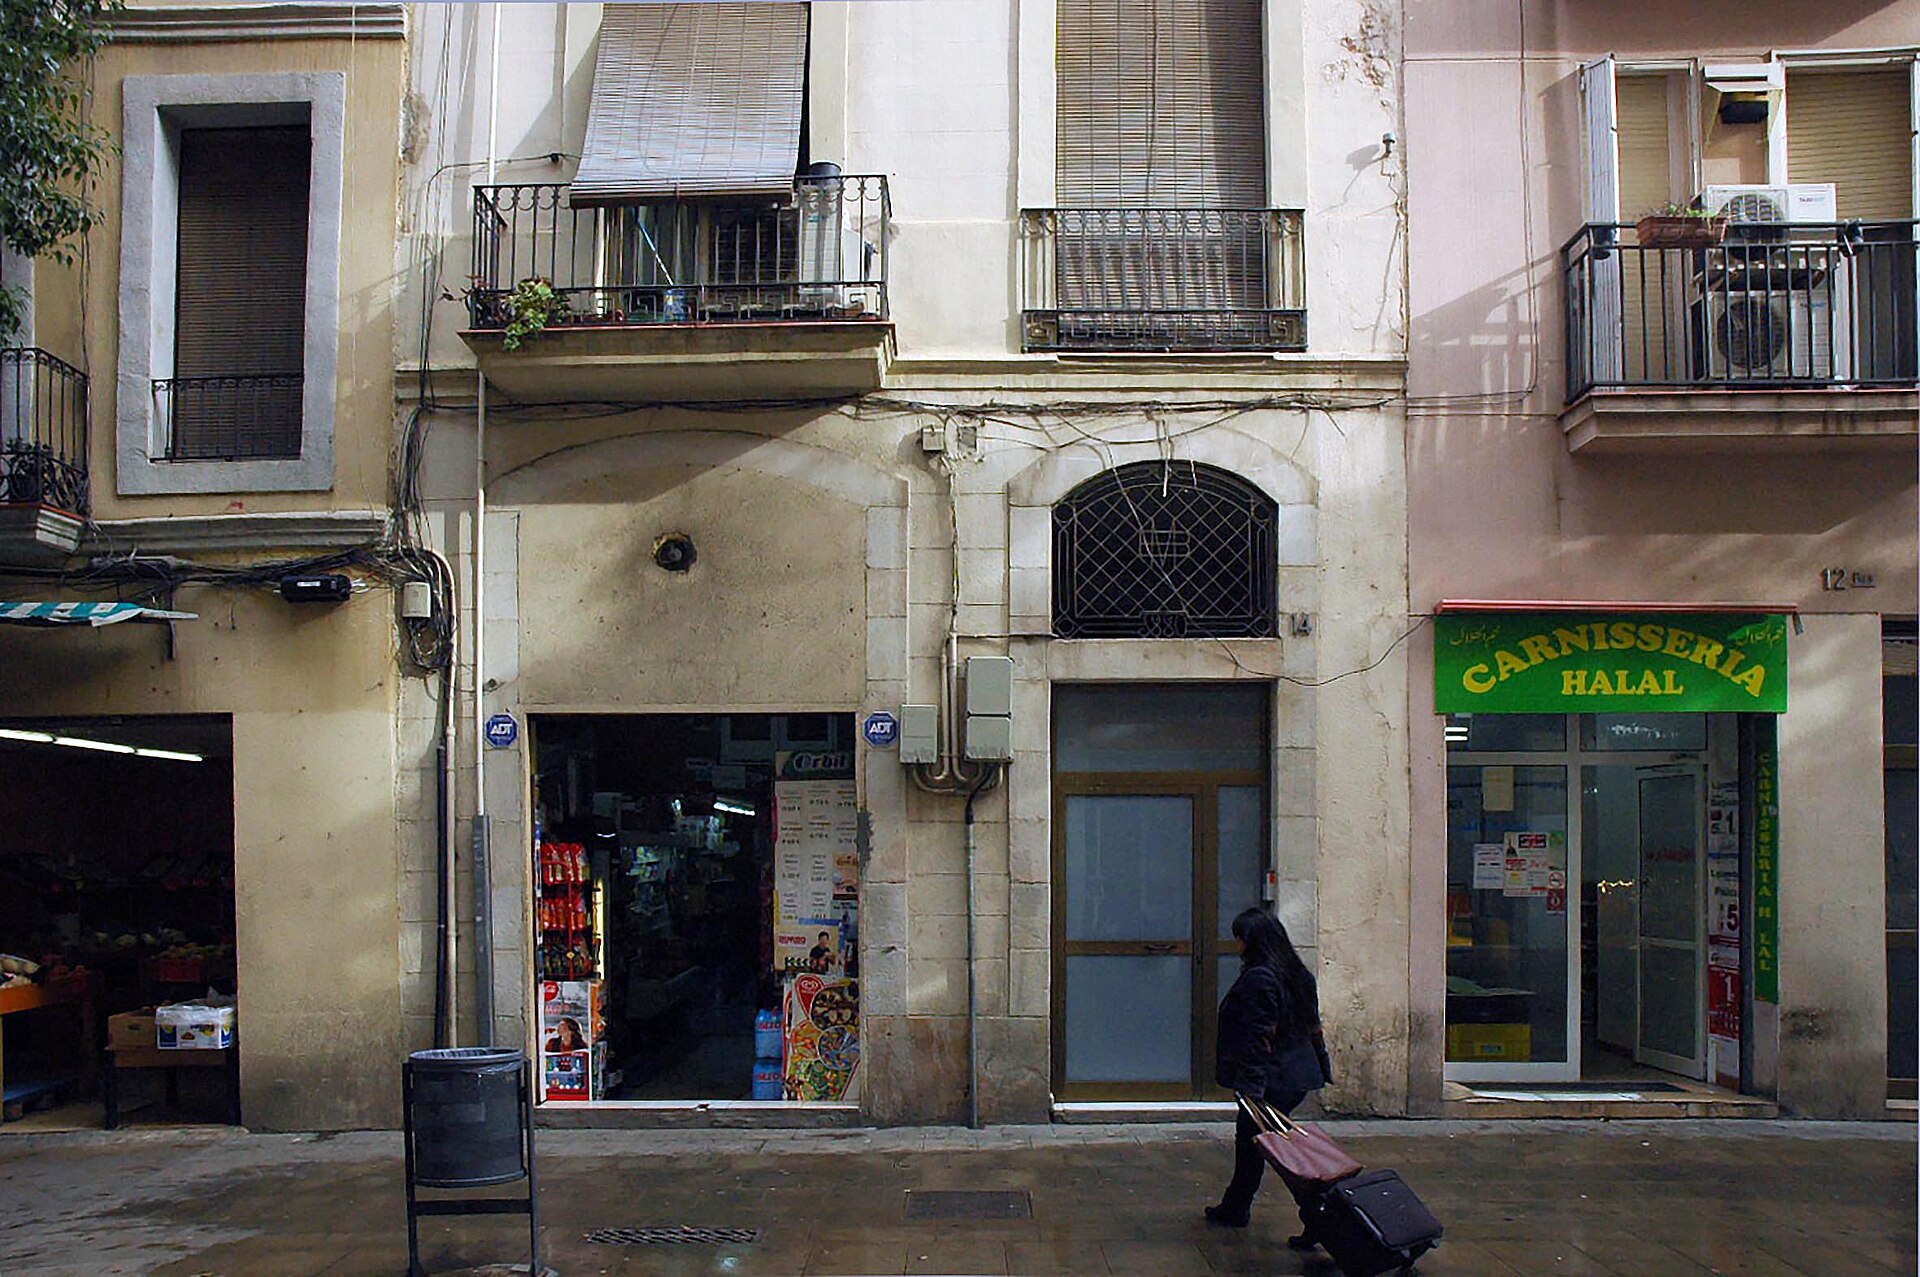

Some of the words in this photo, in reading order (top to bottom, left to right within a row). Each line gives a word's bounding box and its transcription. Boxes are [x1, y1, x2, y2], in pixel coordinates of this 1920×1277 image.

[1820, 567, 1847, 591] 12
[1290, 612, 1312, 636] 14
[1463, 622, 1765, 697] CARNISSERIA
[1561, 670, 1684, 695] HALAL
[490, 723, 513, 735] ADT
[869, 722, 892, 734] ADT
[1758, 905, 1772, 971] HLAL
